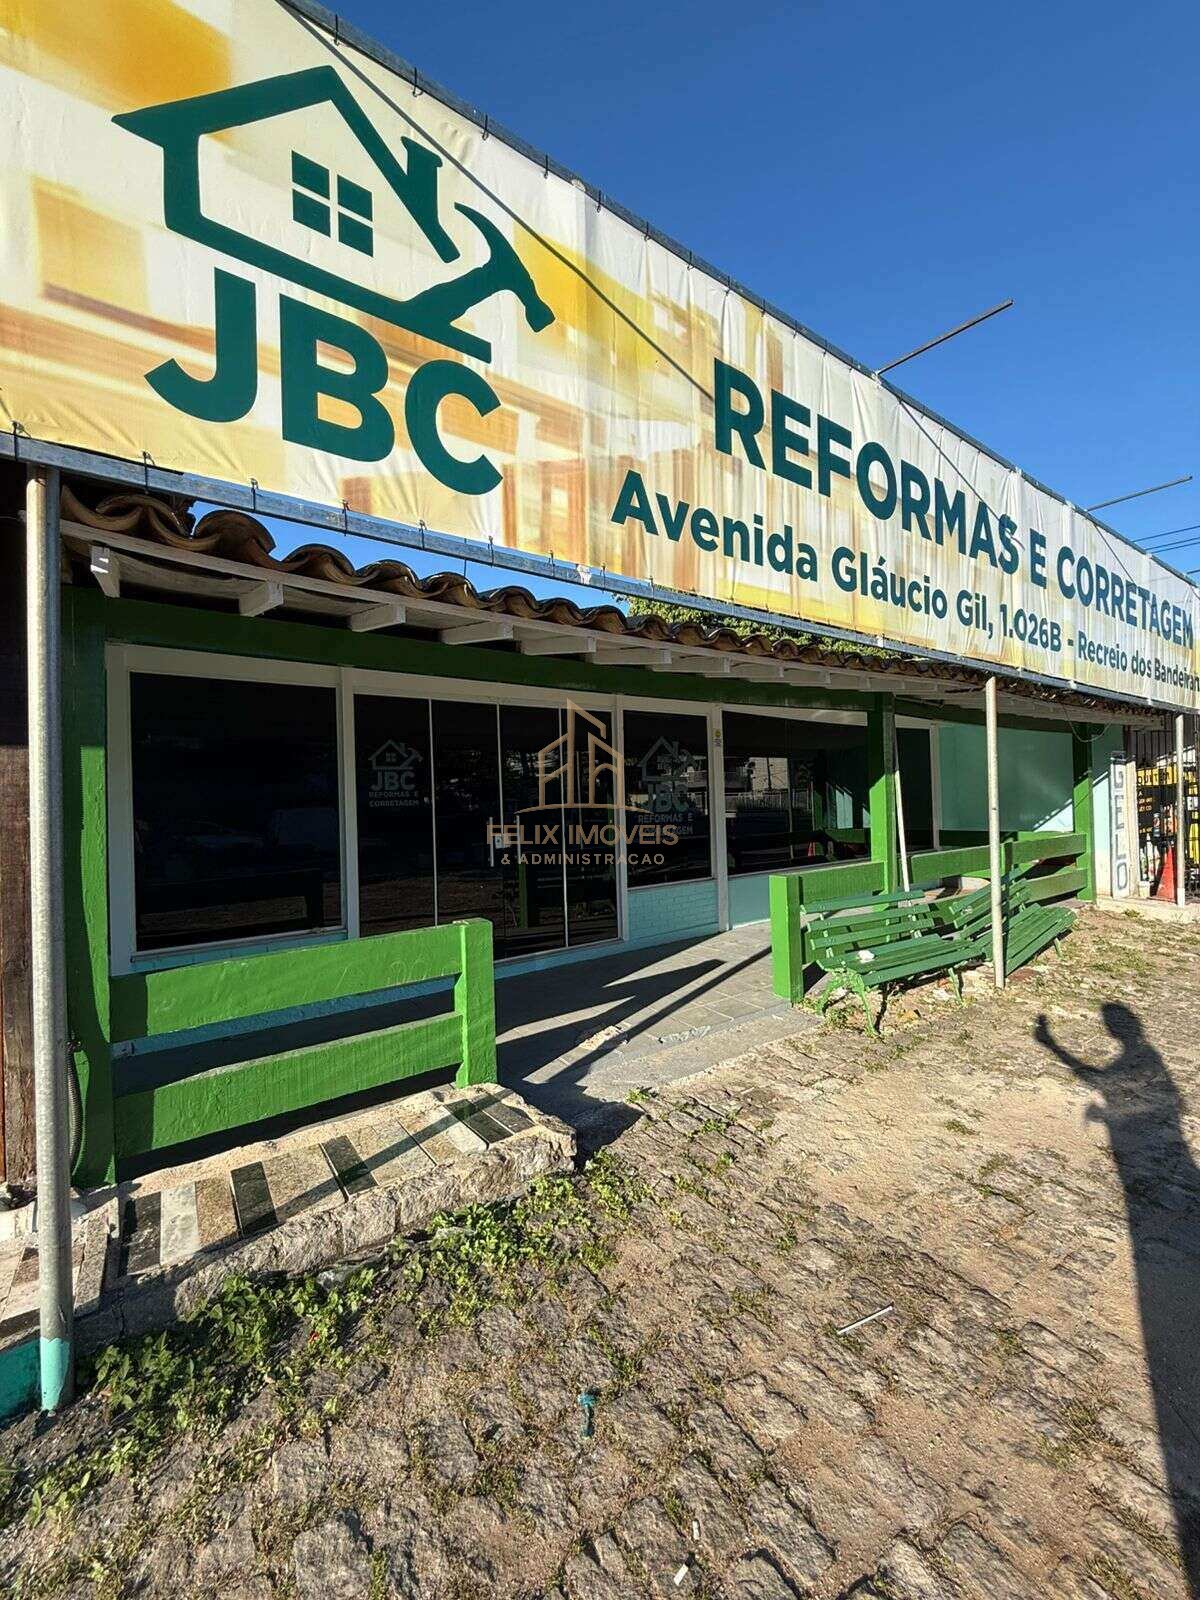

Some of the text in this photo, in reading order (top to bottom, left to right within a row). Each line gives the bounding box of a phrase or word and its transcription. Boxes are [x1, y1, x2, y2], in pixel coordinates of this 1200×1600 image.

[144, 267, 503, 495] JBC
[611, 470, 818, 582] Avenida
[831, 547, 948, 619] Gláucio
[957, 589, 993, 640] Gil,
[1000, 604, 1062, 652] 1.026B
[1078, 630, 1128, 671] Recreio
[1131, 650, 1152, 679] dos
[715, 358, 1194, 649] REFORMAS E CORRETAGEM
[369, 769, 417, 791] JBC
